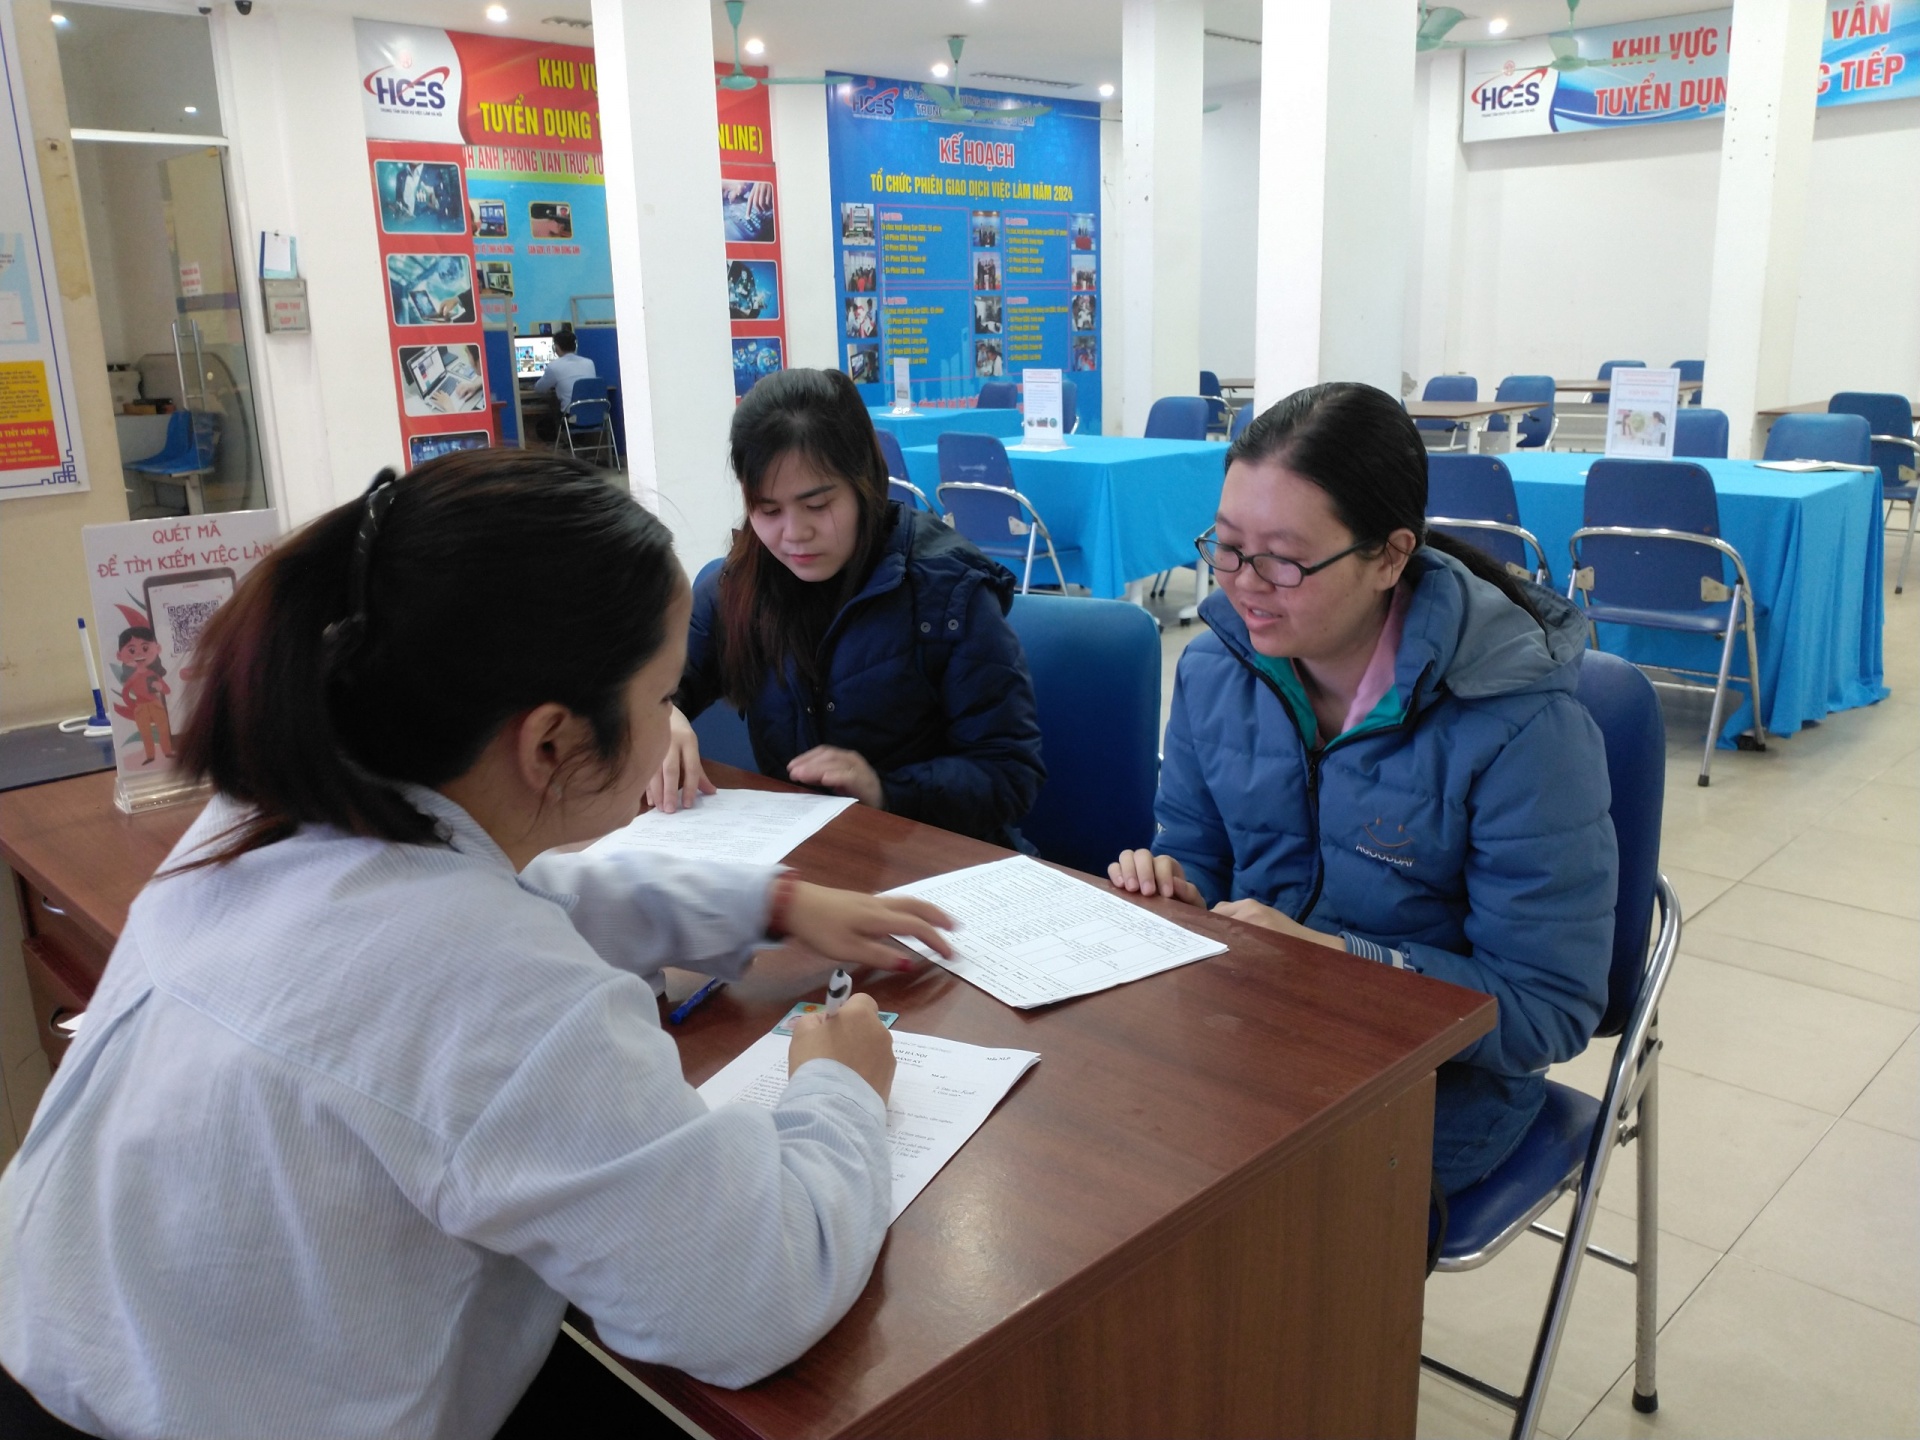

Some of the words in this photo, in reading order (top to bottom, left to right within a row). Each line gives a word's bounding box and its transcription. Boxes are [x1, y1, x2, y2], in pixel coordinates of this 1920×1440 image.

[1611, 35, 1661, 67] KHU
[1669, 26, 1719, 65] VỰC
[538, 57, 575, 90] KHU
[1840, 45, 1905, 92] TIẾP
[375, 76, 446, 110] HCES
[852, 95, 895, 115] HCES
[1481, 82, 1540, 111] HCES
[1594, 72, 1672, 116] TUYỂN
[478, 92, 539, 136] TUYỂN
[543, 107, 592, 144] DỤNG
[939, 131, 964, 164] KẾ
[964, 139, 1015, 171] HOẠCH
[870, 167, 884, 192] TỔ
[886, 172, 912, 193] CHỨC
[914, 174, 943, 195] PHIÊN
[945, 179, 967, 196] GIAO
[968, 180, 989, 200] DỊCH
[991, 179, 1011, 201] VIỆC
[1012, 179, 1031, 200] LÀM
[1032, 180, 1052, 201] NĂM
[1054, 186, 1074, 202] 2024
[152, 523, 192, 544] QUÉT
[197, 520, 221, 539] MÃ
[97, 554, 120, 578] ĐỂ
[124, 555, 153, 575] TÌM
[158, 546, 196, 570] KIẾM
[200, 544, 239, 565] VIỆC
